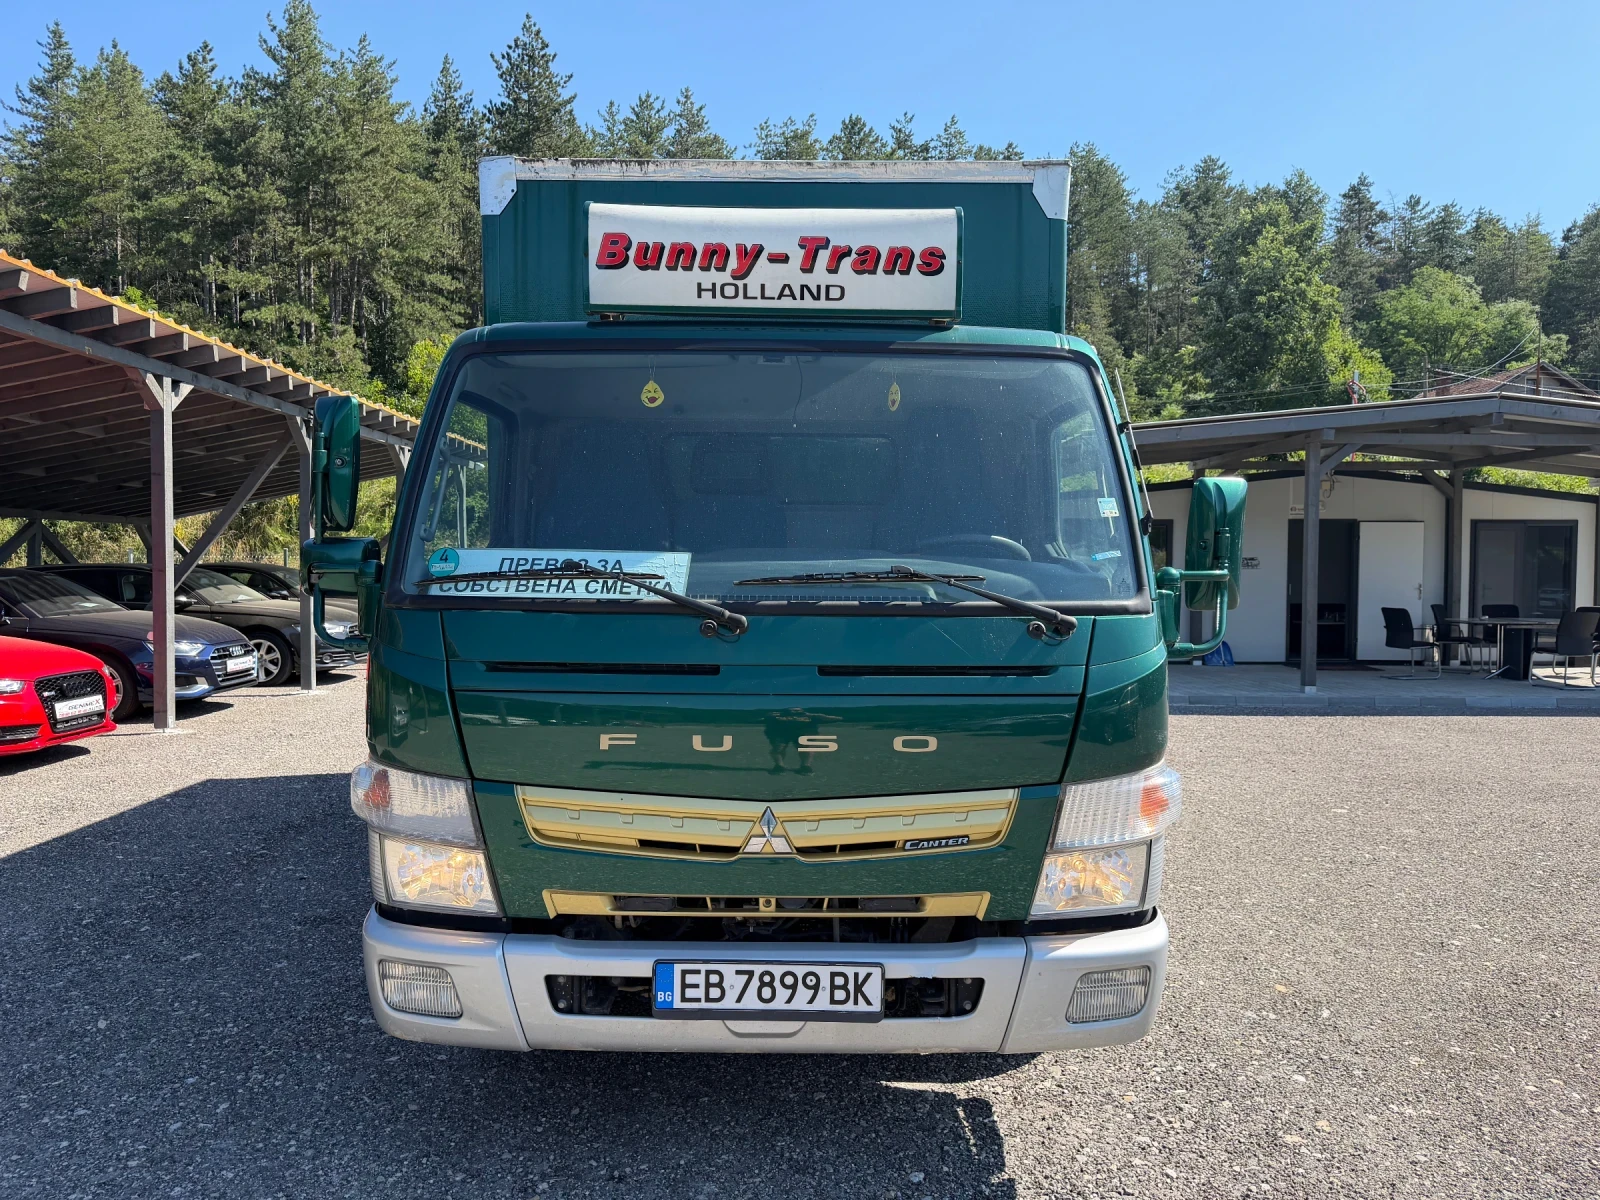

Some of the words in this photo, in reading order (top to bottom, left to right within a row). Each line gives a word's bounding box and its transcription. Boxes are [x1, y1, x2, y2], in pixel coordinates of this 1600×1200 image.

[595, 231, 947, 281] Bunny-Trans
[696, 282, 846, 302] HOLLAND
[439, 548, 449, 563] 4
[597, 559, 624, 575] ЗА
[438, 578, 577, 594] СОБСТВЕНА
[599, 733, 938, 753] FUSO
[904, 837, 969, 850] CANTER
[679, 968, 726, 1004] EB
[734, 969, 821, 1005] 7899
[829, 971, 874, 1006] BK
[657, 991, 673, 1002] BG
